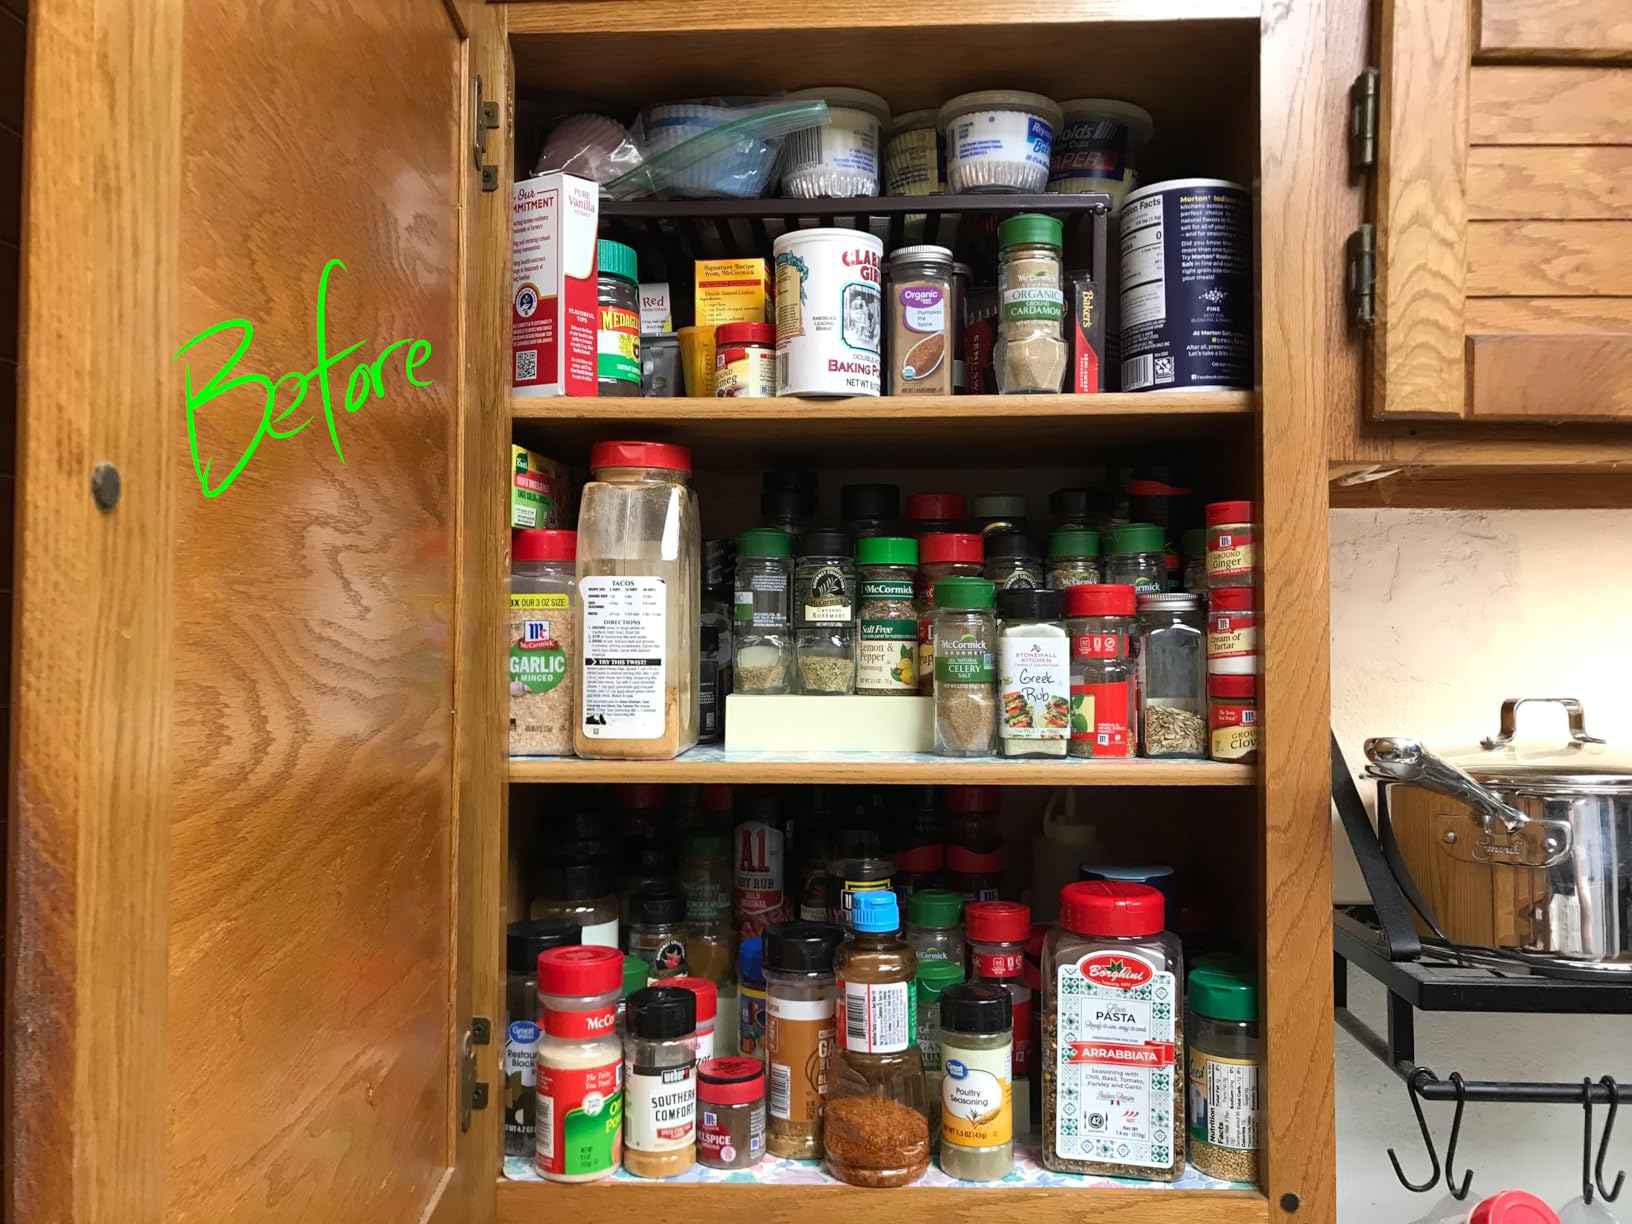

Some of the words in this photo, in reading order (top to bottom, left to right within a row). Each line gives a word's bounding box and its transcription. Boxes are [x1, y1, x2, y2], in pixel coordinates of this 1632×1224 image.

[518, 188, 536, 200] Our
[574, 188, 590, 199] PURE
[568, 195, 595, 214] Vanilla
[1140, 198, 1160, 210] Facts
[905, 289, 938, 300] Organic
[1013, 290, 1060, 300] ORGANIC
[642, 296, 664, 308] Red
[568, 308, 594, 320] FLAVORFUL
[853, 354, 874, 362] DOUBLE
[828, 360, 870, 374] BAKING
[846, 378, 860, 387] NET
[860, 379, 870, 388] WT
[1214, 551, 1240, 560] GROUND
[1213, 558, 1242, 569] Ginger
[864, 584, 913, 595] McCormick
[862, 625, 875, 633] Salt
[875, 625, 893, 633] Free
[1210, 635, 1230, 644] Cream
[1232, 633, 1241, 641] of
[520, 640, 554, 649] McCormick
[860, 643, 884, 652] Lemon
[887, 643, 894, 652] &
[941, 640, 987, 650] McCormick
[1213, 642, 1235, 650] Tartar
[860, 653, 885, 664] Pepper
[510, 656, 565, 673] GARLIC
[948, 664, 982, 673] CELERY
[521, 674, 554, 682] MINCED
[1020, 668, 1055, 684] Greek
[1022, 687, 1049, 702] Rub
[754, 879, 774, 888] RUB
[1089, 964, 1144, 982] Borghini
[1096, 1012, 1136, 1023] PASTA
[512, 1027, 534, 1036] Great
[517, 1032, 534, 1040] Value
[1082, 1048, 1158, 1061] ARRABBIATA
[512, 1059, 535, 1068] Black
[1091, 1068, 1123, 1076] Seasoning
[586, 1074, 596, 1082] The
[1120, 1077, 1144, 1085] Tomato,
[956, 1088, 981, 1098] Poultry
[950, 1094, 988, 1107] Seasoning
[656, 1102, 694, 1121] COMFORT
[964, 1130, 972, 1138] OZ
